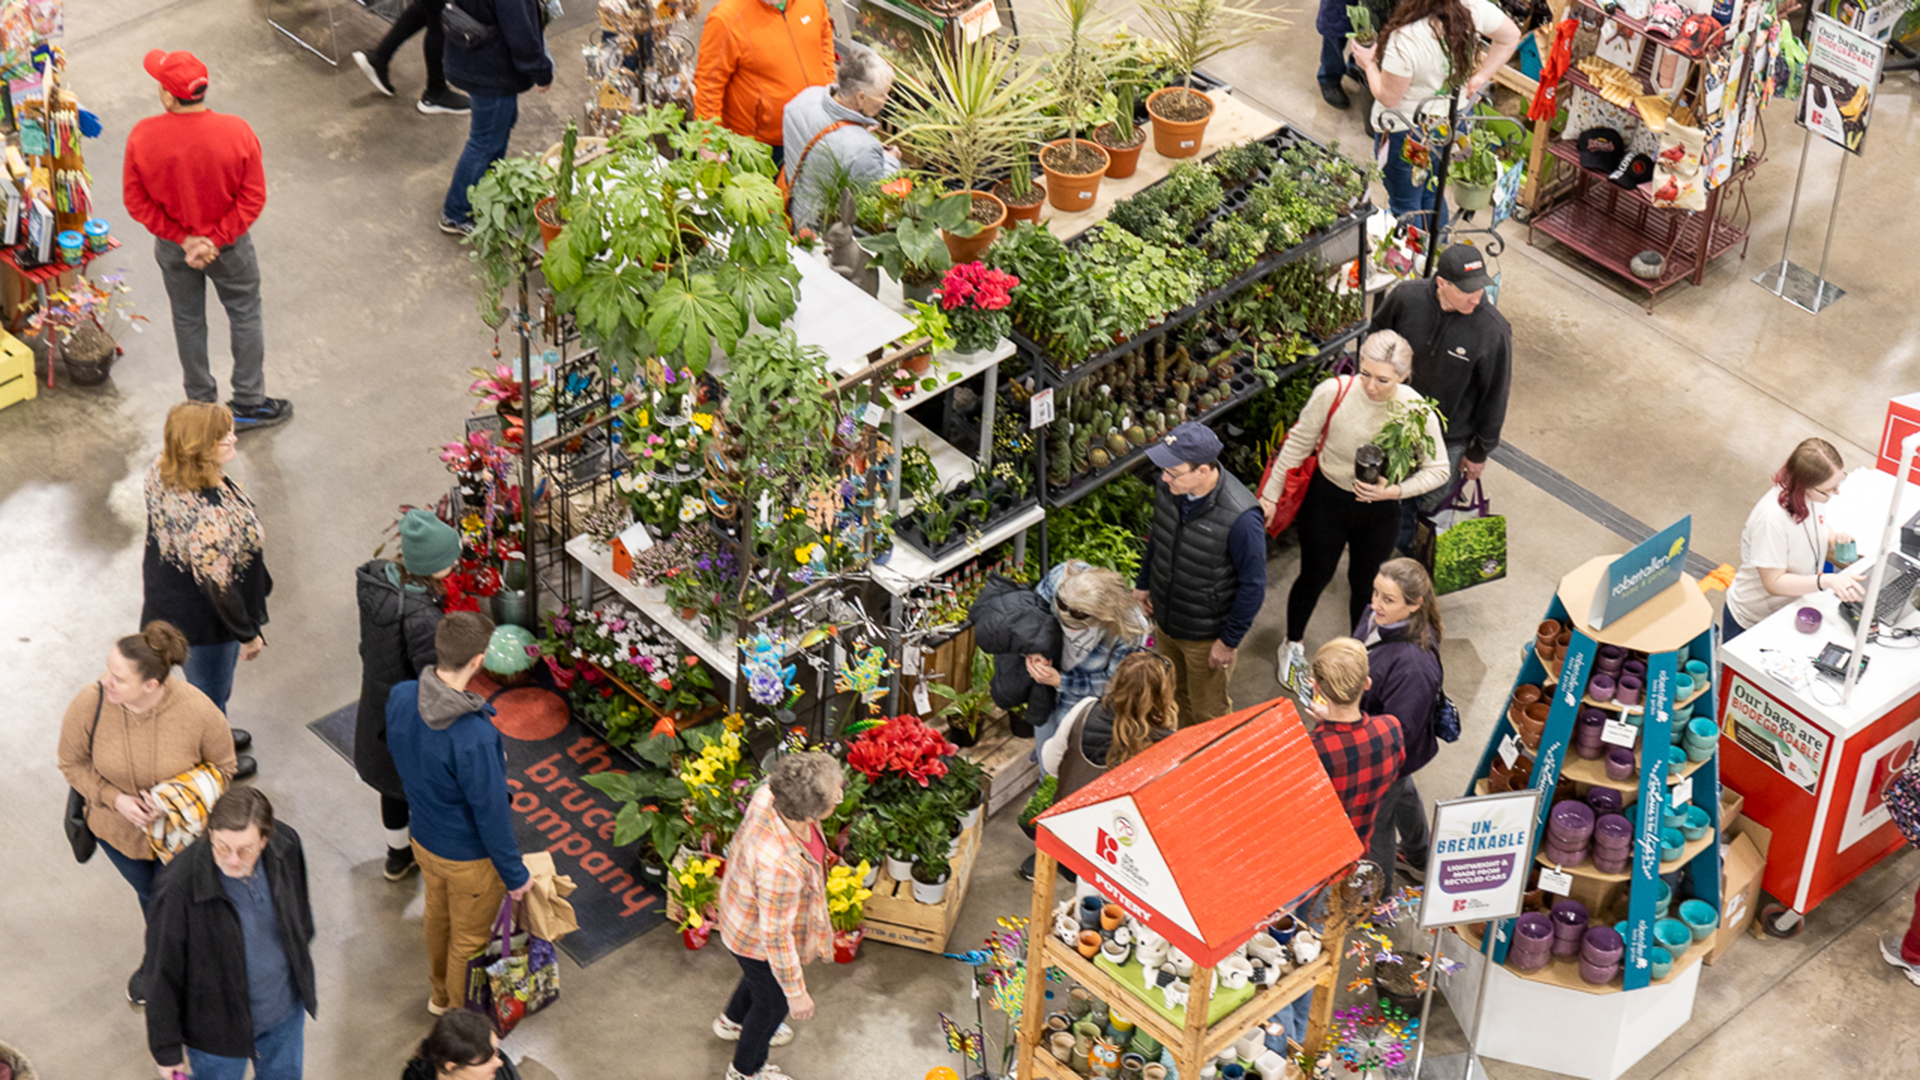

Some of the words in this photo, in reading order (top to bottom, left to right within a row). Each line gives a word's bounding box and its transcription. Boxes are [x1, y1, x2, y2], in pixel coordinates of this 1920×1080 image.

[1817, 35, 1875, 70] BIODEGRADABLE
[1819, 26, 1837, 43] Our
[1838, 34, 1860, 54] bags
[1861, 50, 1877, 61] are
[1731, 697, 1820, 764] BIODEGRADABLE
[1734, 684, 1762, 709] Our
[1763, 701, 1798, 733] bags
[1798, 728, 1823, 751] are
[566, 736, 630, 775] th
[523, 753, 617, 840] bruce
[1437, 831, 1525, 854] BREAKABLE
[1471, 820, 1498, 835] UN-
[1444, 876, 1484, 886] RECYCLED
[1485, 873, 1507, 881] CARS
[1447, 862, 1500, 872] LIGHTWEIGHT
[1500, 859, 1509, 867] &
[1453, 870, 1476, 878] MADE
[1477, 867, 1500, 875] FROM
[1094, 872, 1152, 921] POTTERY
